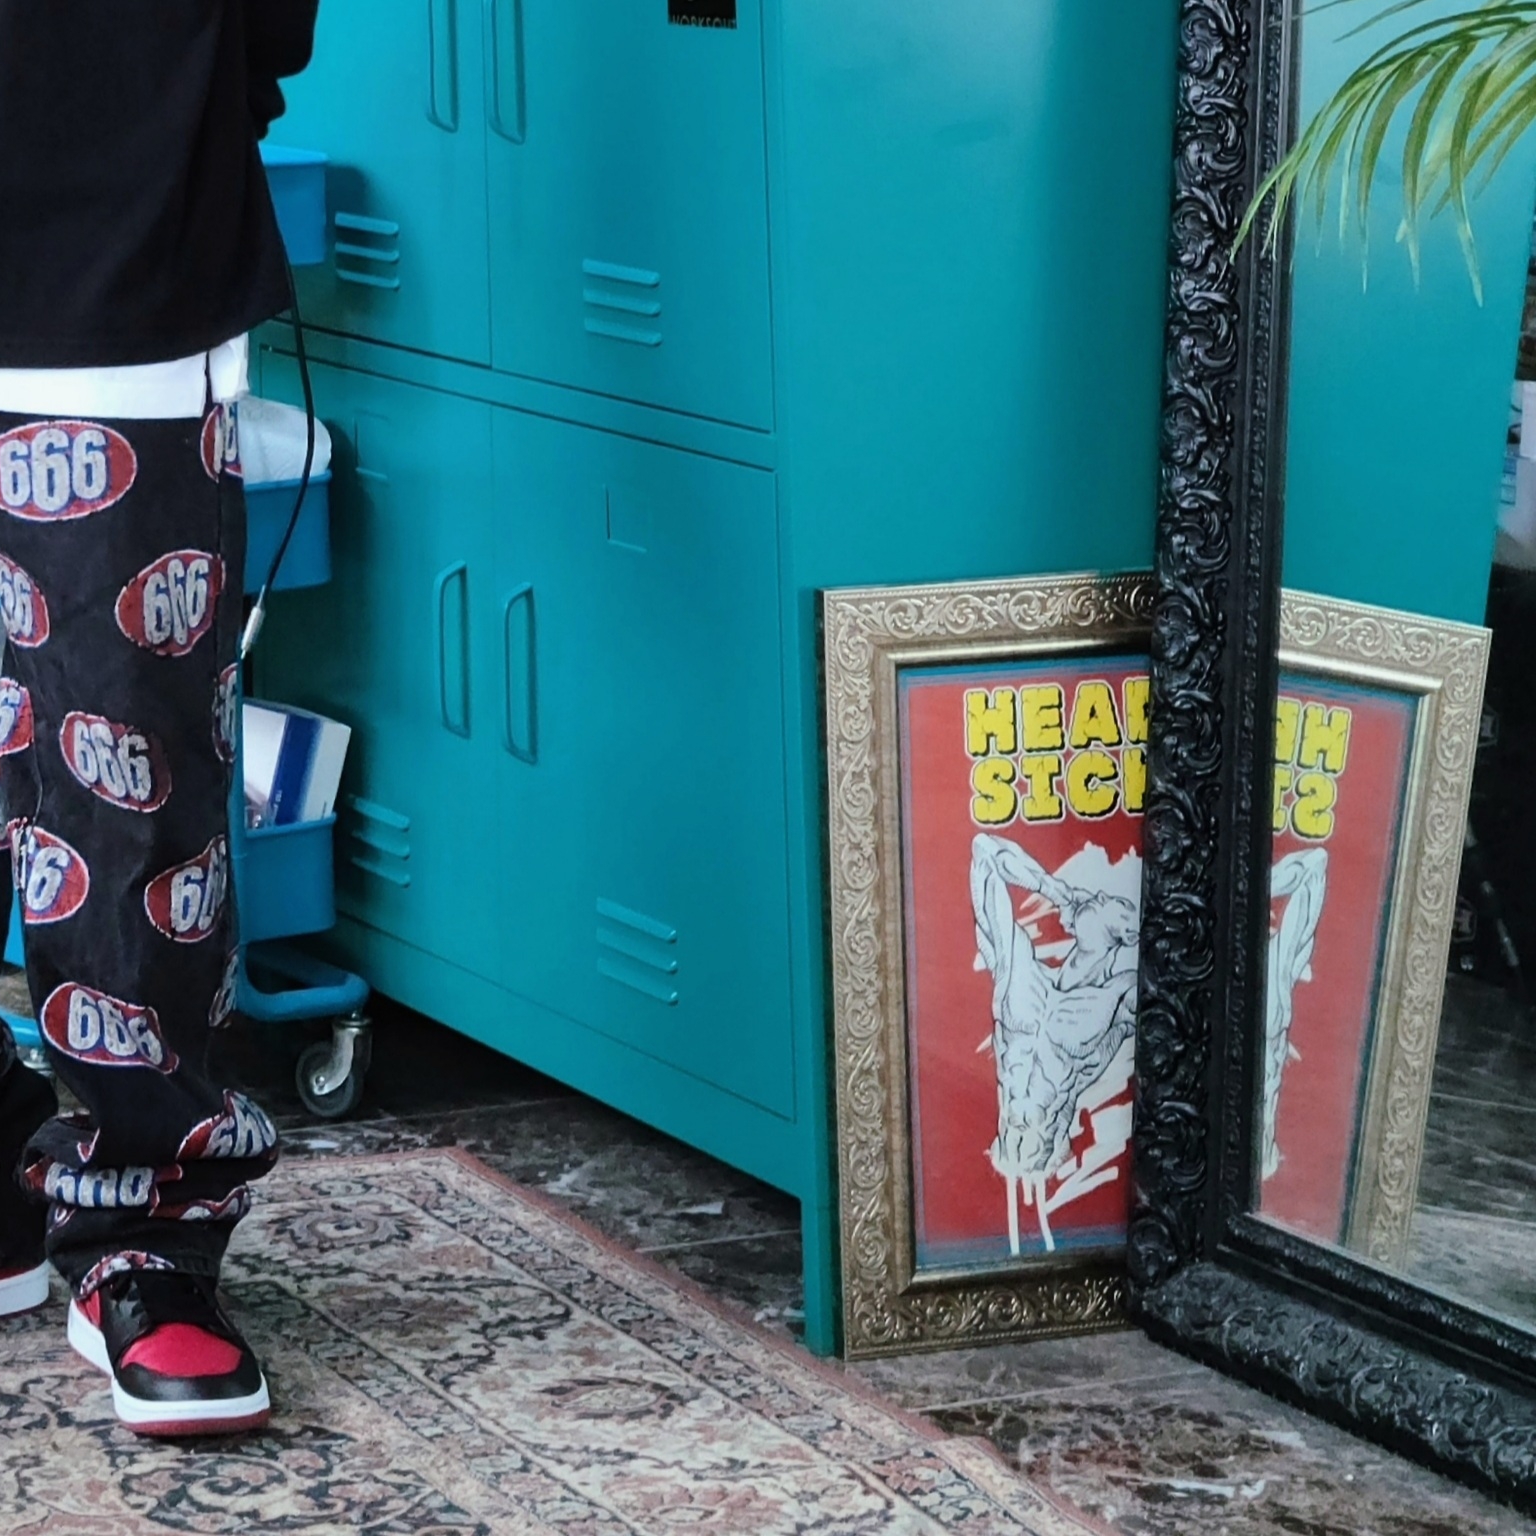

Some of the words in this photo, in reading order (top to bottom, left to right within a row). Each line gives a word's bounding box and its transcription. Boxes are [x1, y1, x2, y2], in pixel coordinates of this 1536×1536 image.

[143, 558, 209, 646] 666
[70, 719, 154, 801] 666
[67, 987, 164, 1065] 666
